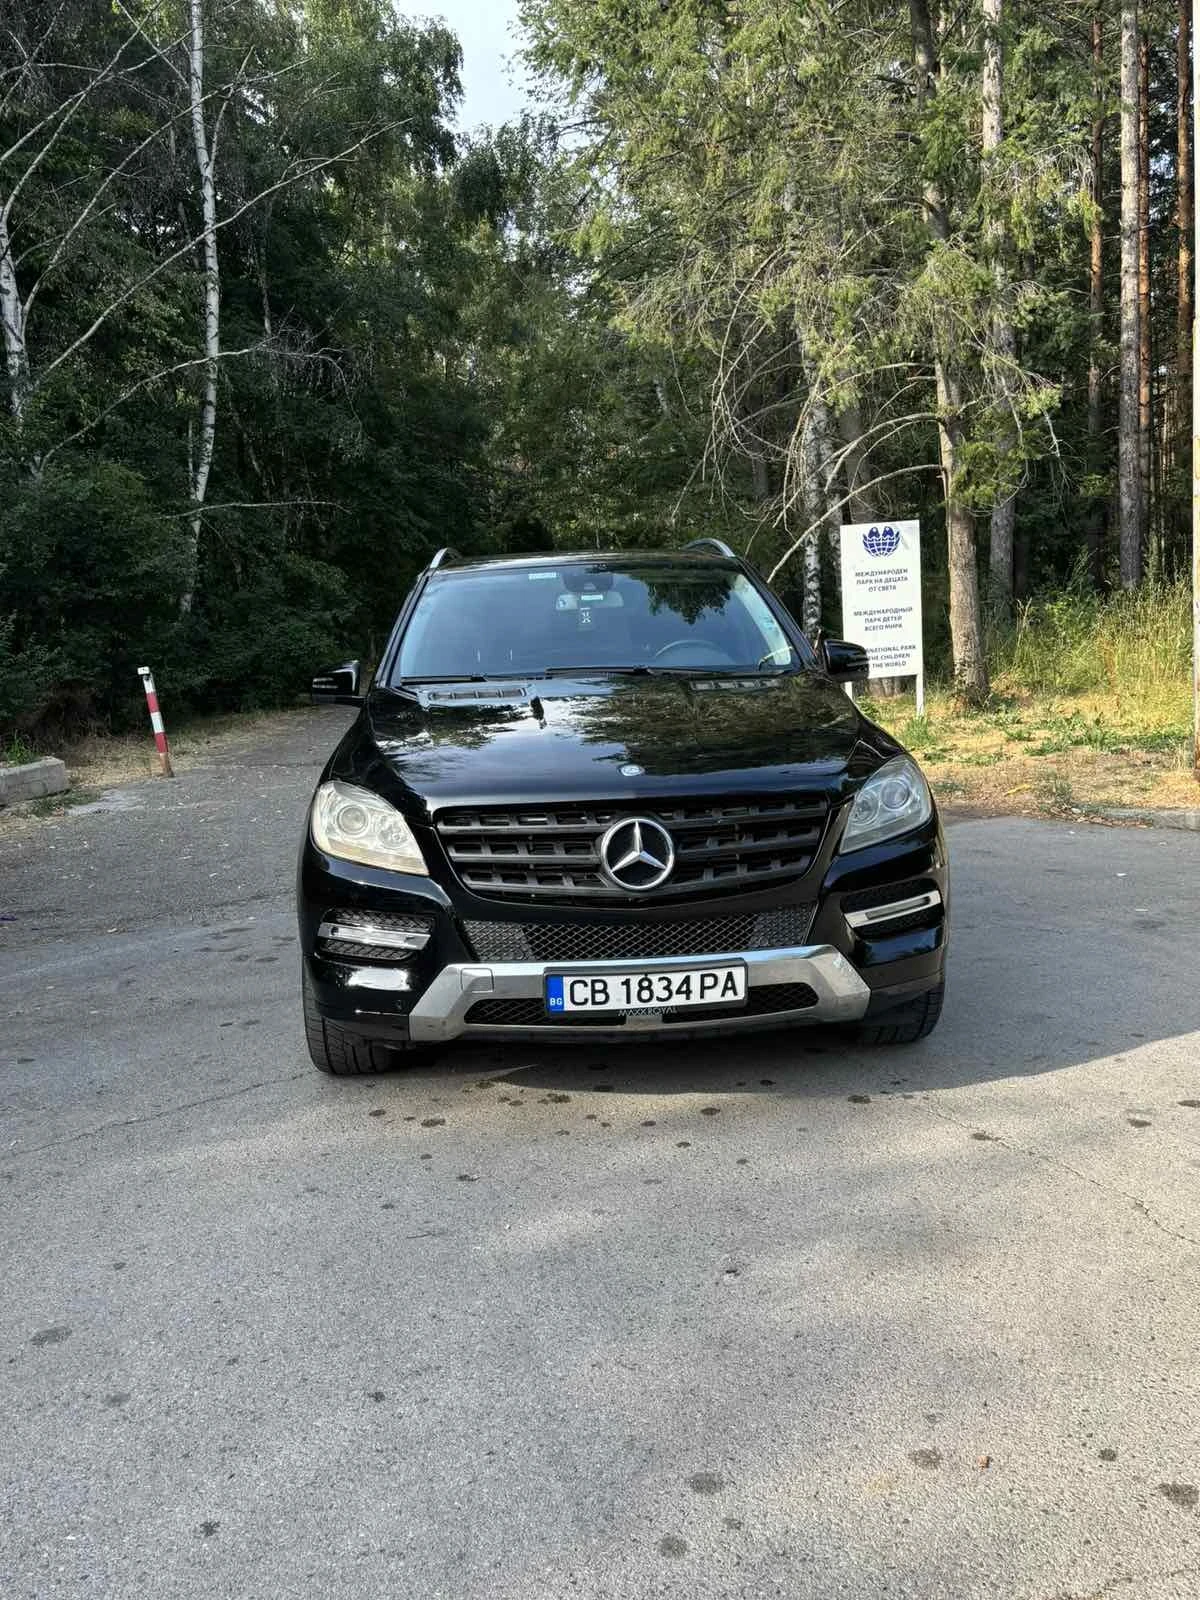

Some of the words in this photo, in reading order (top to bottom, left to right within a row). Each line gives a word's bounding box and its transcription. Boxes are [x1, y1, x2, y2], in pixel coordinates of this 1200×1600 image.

[855, 568, 908, 577] МЕЖДУНАРОДЕН
[884, 576, 908, 584] ДЕЦАТА
[853, 606, 912, 616] МЕЖДУНАРОДНЫЙ
[880, 652, 911, 660] CHILDREN
[569, 979, 610, 1006] CB
[620, 974, 692, 1004] 1834
[699, 971, 738, 999] PA
[549, 997, 563, 1006] BG
